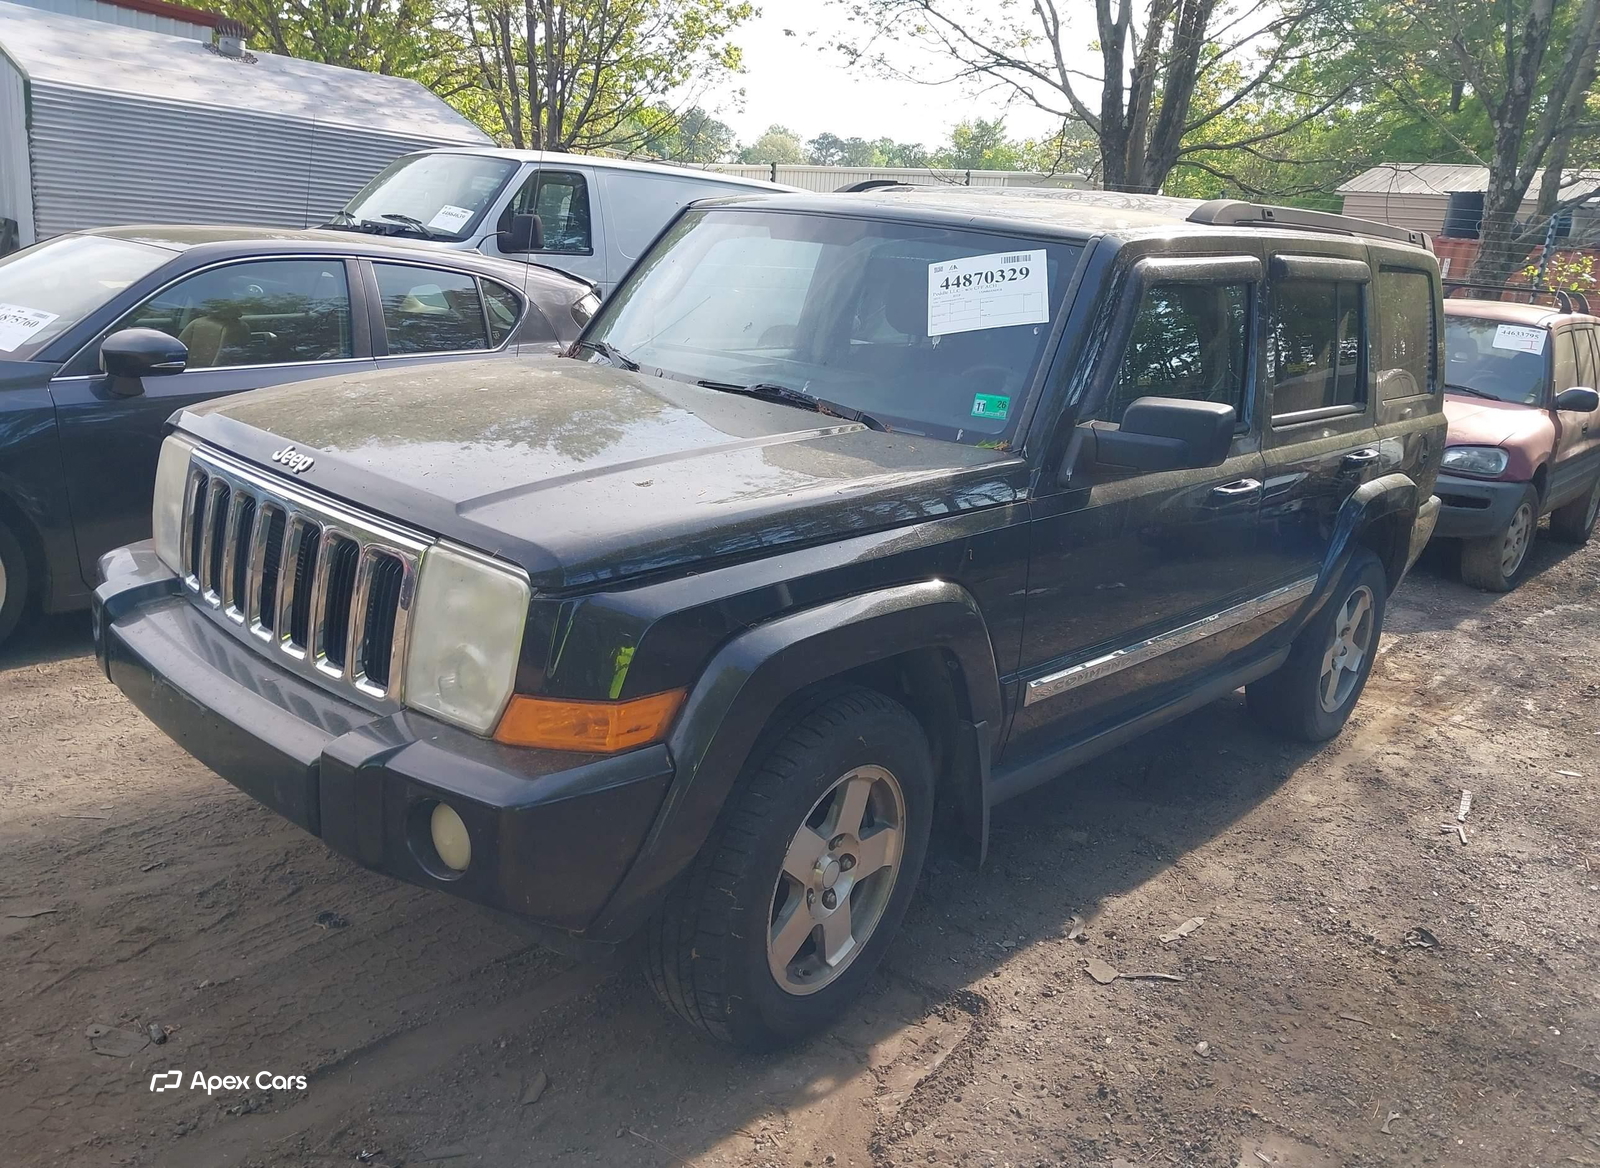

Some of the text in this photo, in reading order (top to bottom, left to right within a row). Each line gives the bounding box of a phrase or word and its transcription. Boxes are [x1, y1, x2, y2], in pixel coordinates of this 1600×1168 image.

[940, 266, 1030, 290] 44870329
[1501, 330, 1540, 340] 44633795
[976, 400, 1007, 412] 11 26
[272, 445, 315, 475] Jeep
